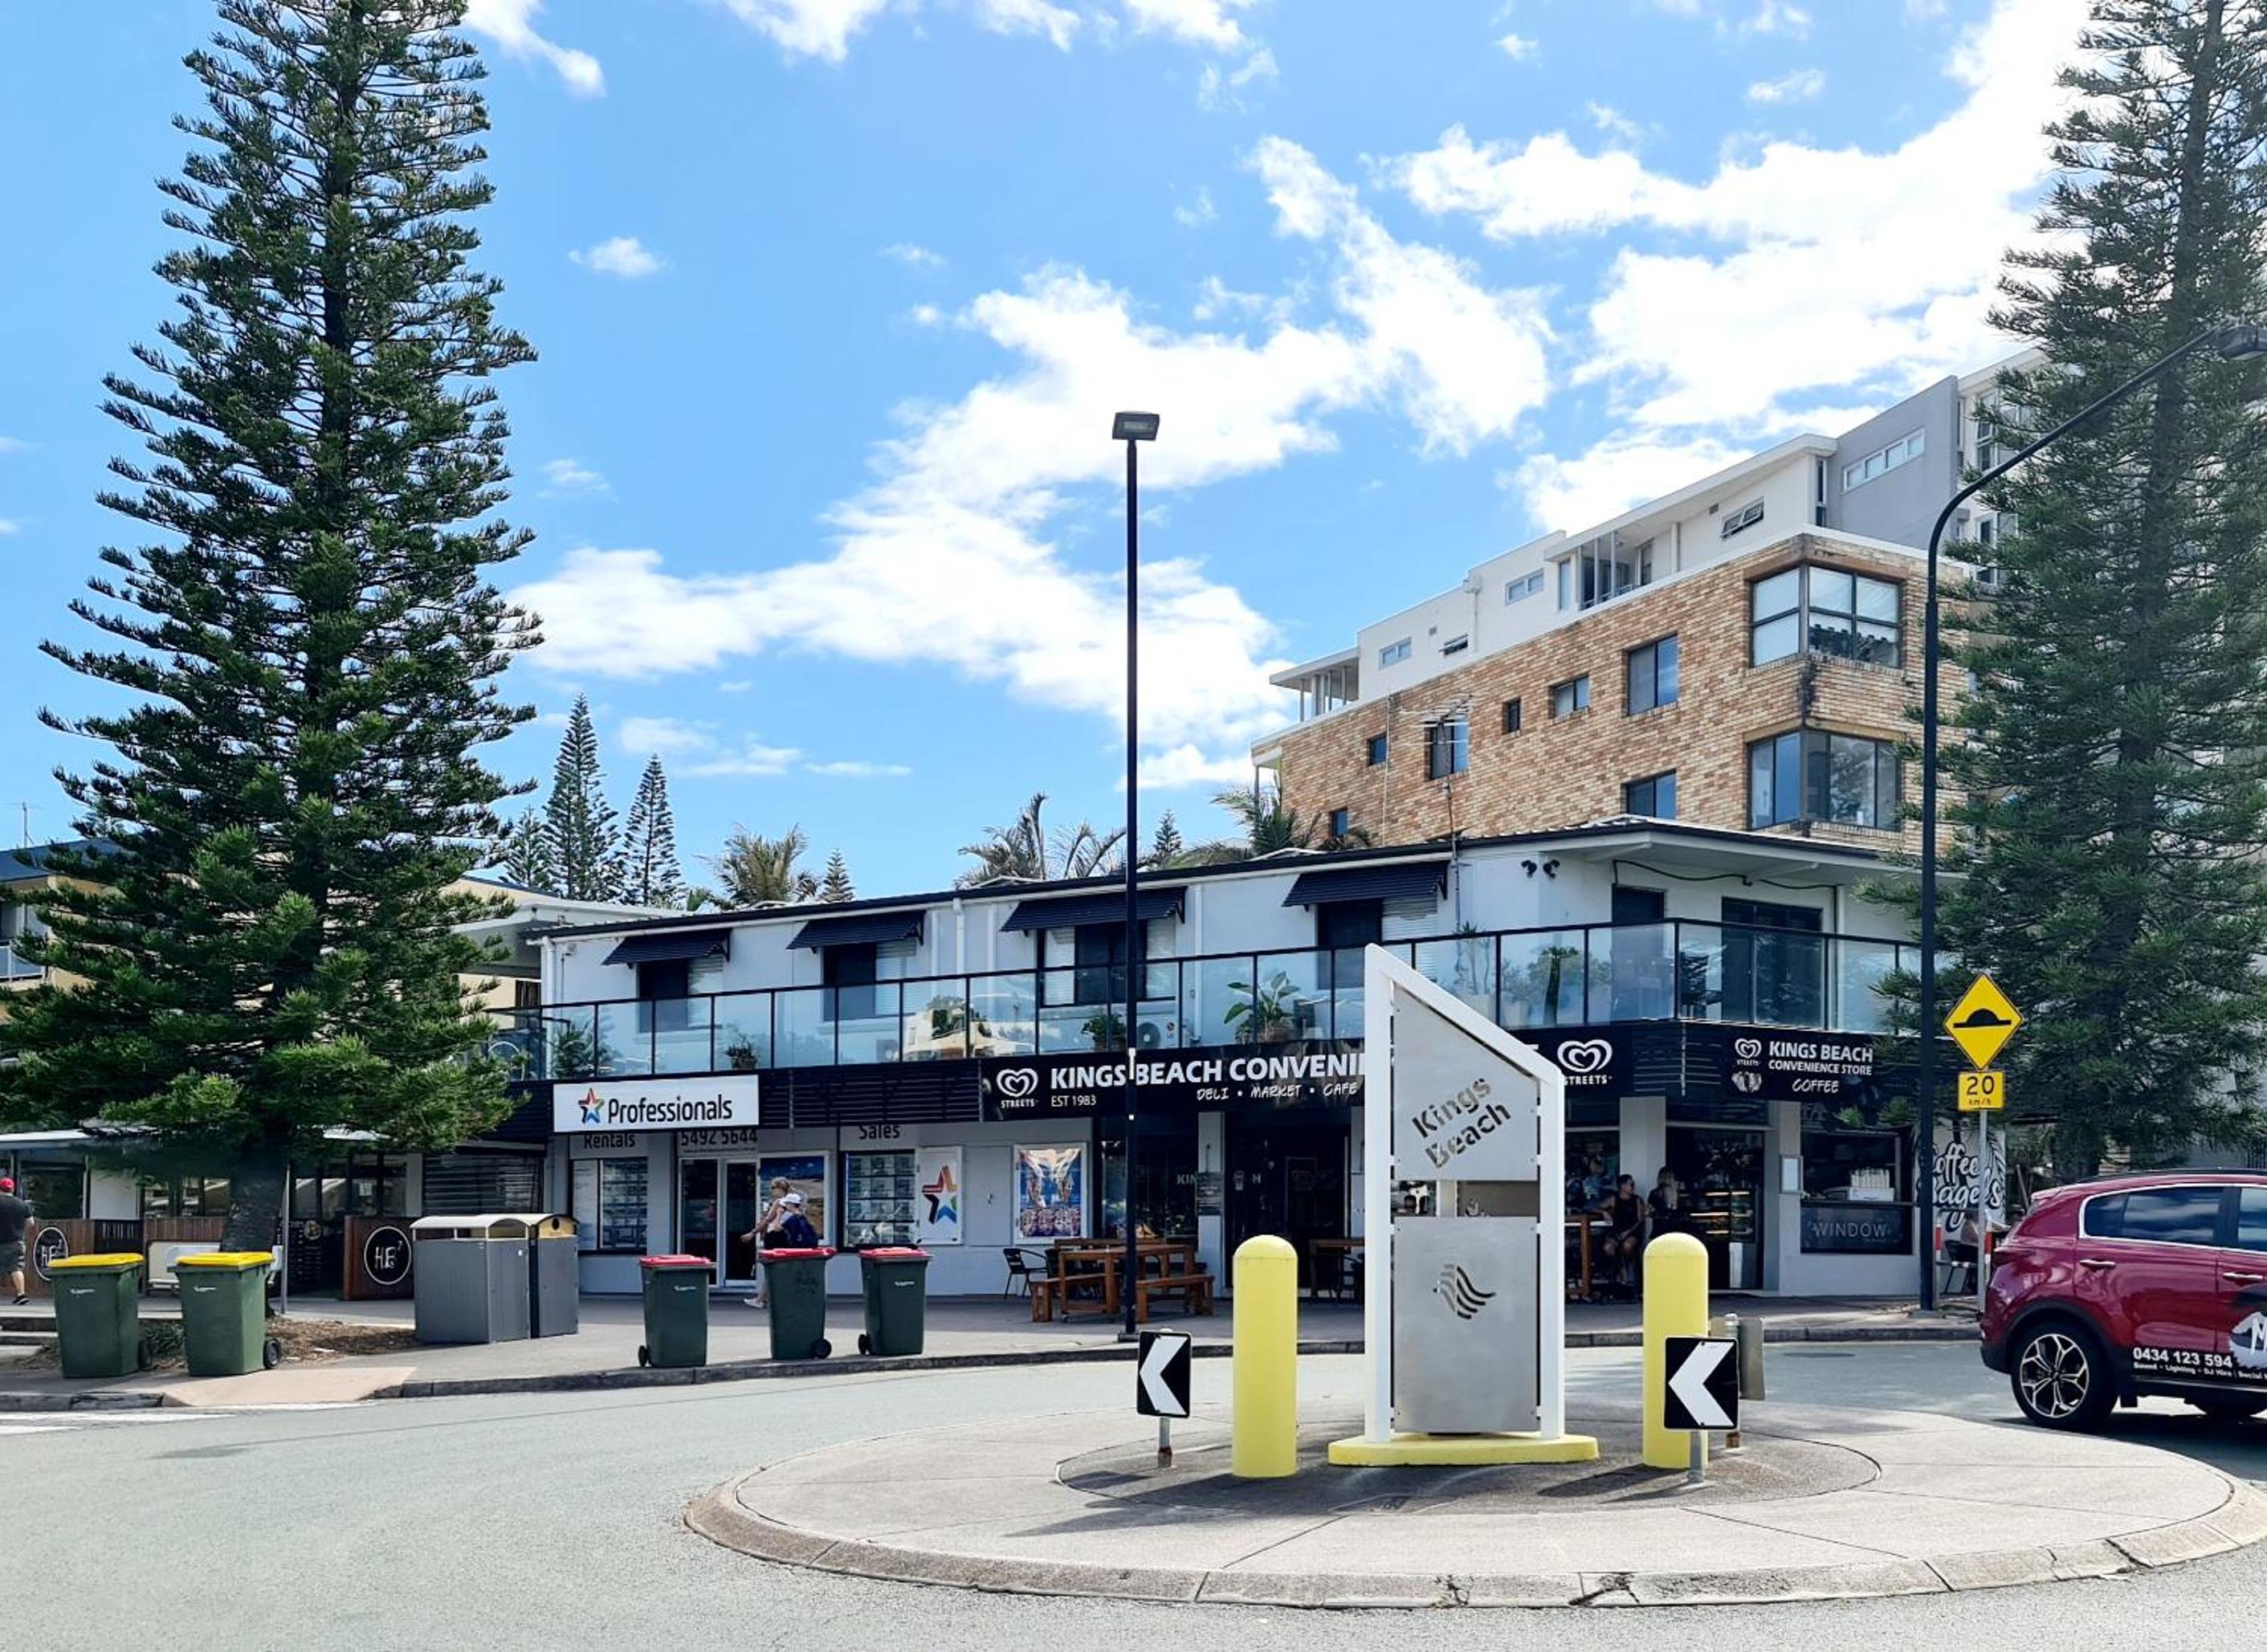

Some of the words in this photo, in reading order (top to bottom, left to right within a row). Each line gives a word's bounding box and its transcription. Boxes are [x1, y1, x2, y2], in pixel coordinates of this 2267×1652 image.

[1769, 1041, 1817, 1059] KINGS
[1821, 1045, 1874, 1063] BEACH
[1050, 1064, 1126, 1089] KINGS
[1136, 1059, 1222, 1085] BEACH
[1768, 1059, 1839, 1074] CONVENIENCE
[1841, 1064, 1873, 1076] STORE
[1563, 1075, 1608, 1086] STREETS
[1792, 1078, 1839, 1094] COFFEE
[1966, 1075, 1995, 1095] 20
[1051, 1095, 1070, 1107] EST
[1072, 1095, 1097, 1106] 1983
[1197, 1087, 1229, 1101] DELI
[1250, 1084, 1302, 1099] MARKET
[608, 1094, 732, 1124] Professionals
[1001, 1098, 1035, 1109] STREETS
[1412, 1078, 1491, 1139] Kings
[584, 1132, 635, 1149] Rentals
[681, 1129, 716, 1146] 5492
[858, 1124, 900, 1140] Sales
[1425, 1103, 1511, 1169] Beach
[1931, 1142, 1980, 1184] offee
[1813, 1222, 1887, 1238] WINDOW
[2133, 1347, 2169, 1362] 0434
[2173, 1351, 2200, 1365] 123
[2204, 1354, 2232, 1368] 594
